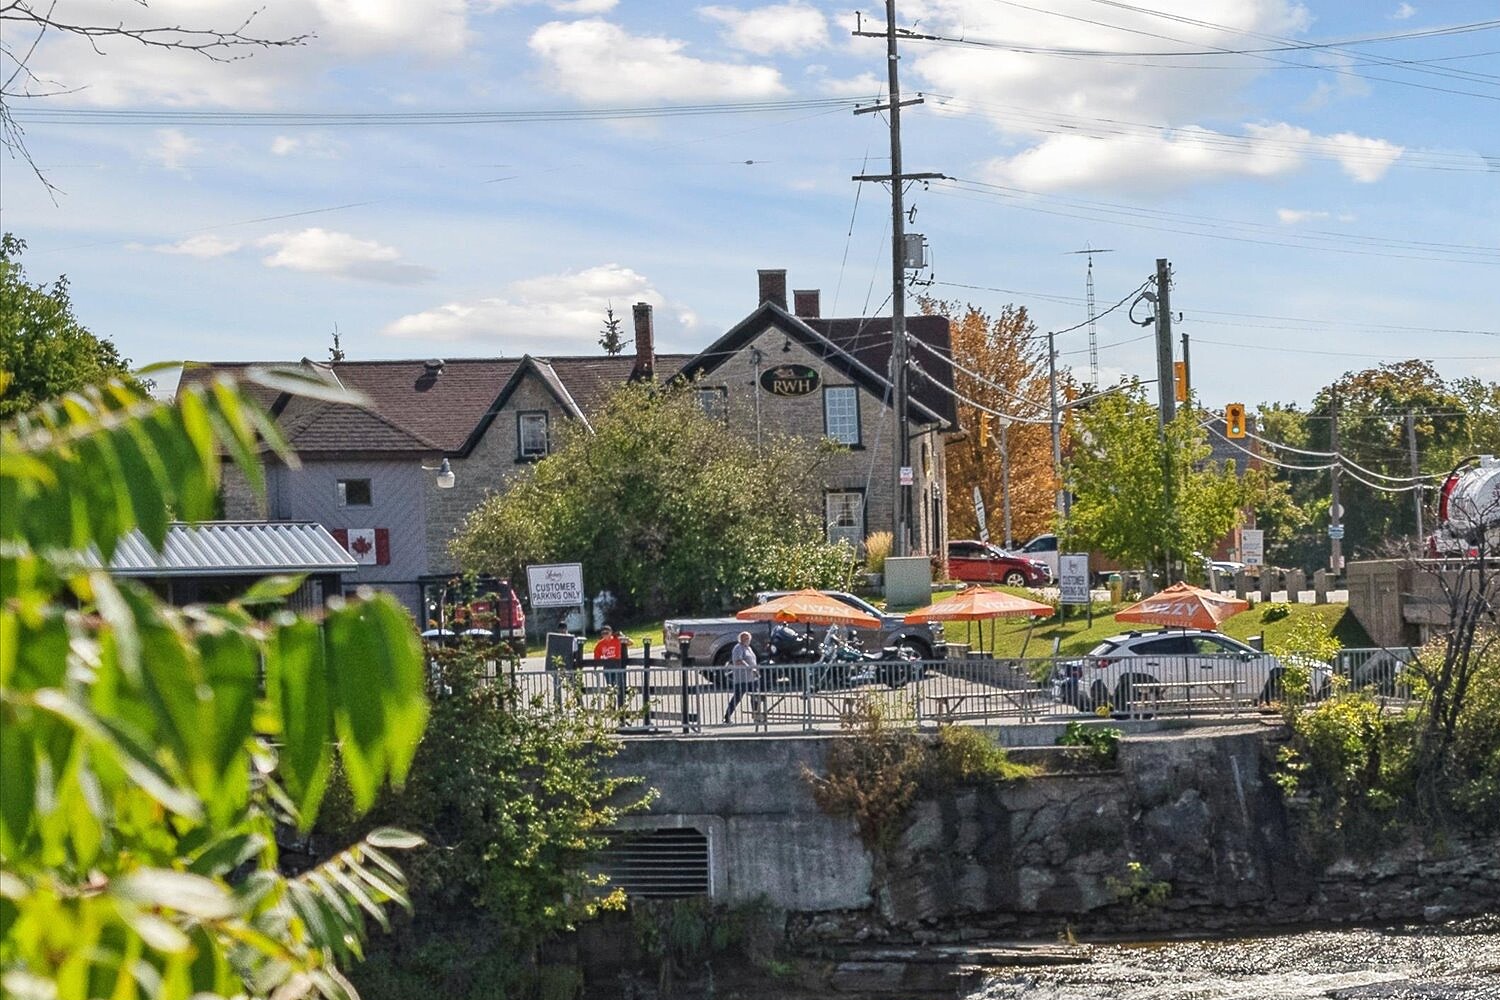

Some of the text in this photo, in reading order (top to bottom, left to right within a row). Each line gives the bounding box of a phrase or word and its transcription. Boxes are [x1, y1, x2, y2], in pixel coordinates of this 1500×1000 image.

[773, 380, 810, 392] RWH
[535, 582, 577, 592] CUSTOMER
[532, 591, 581, 601] PARKING ONLY
